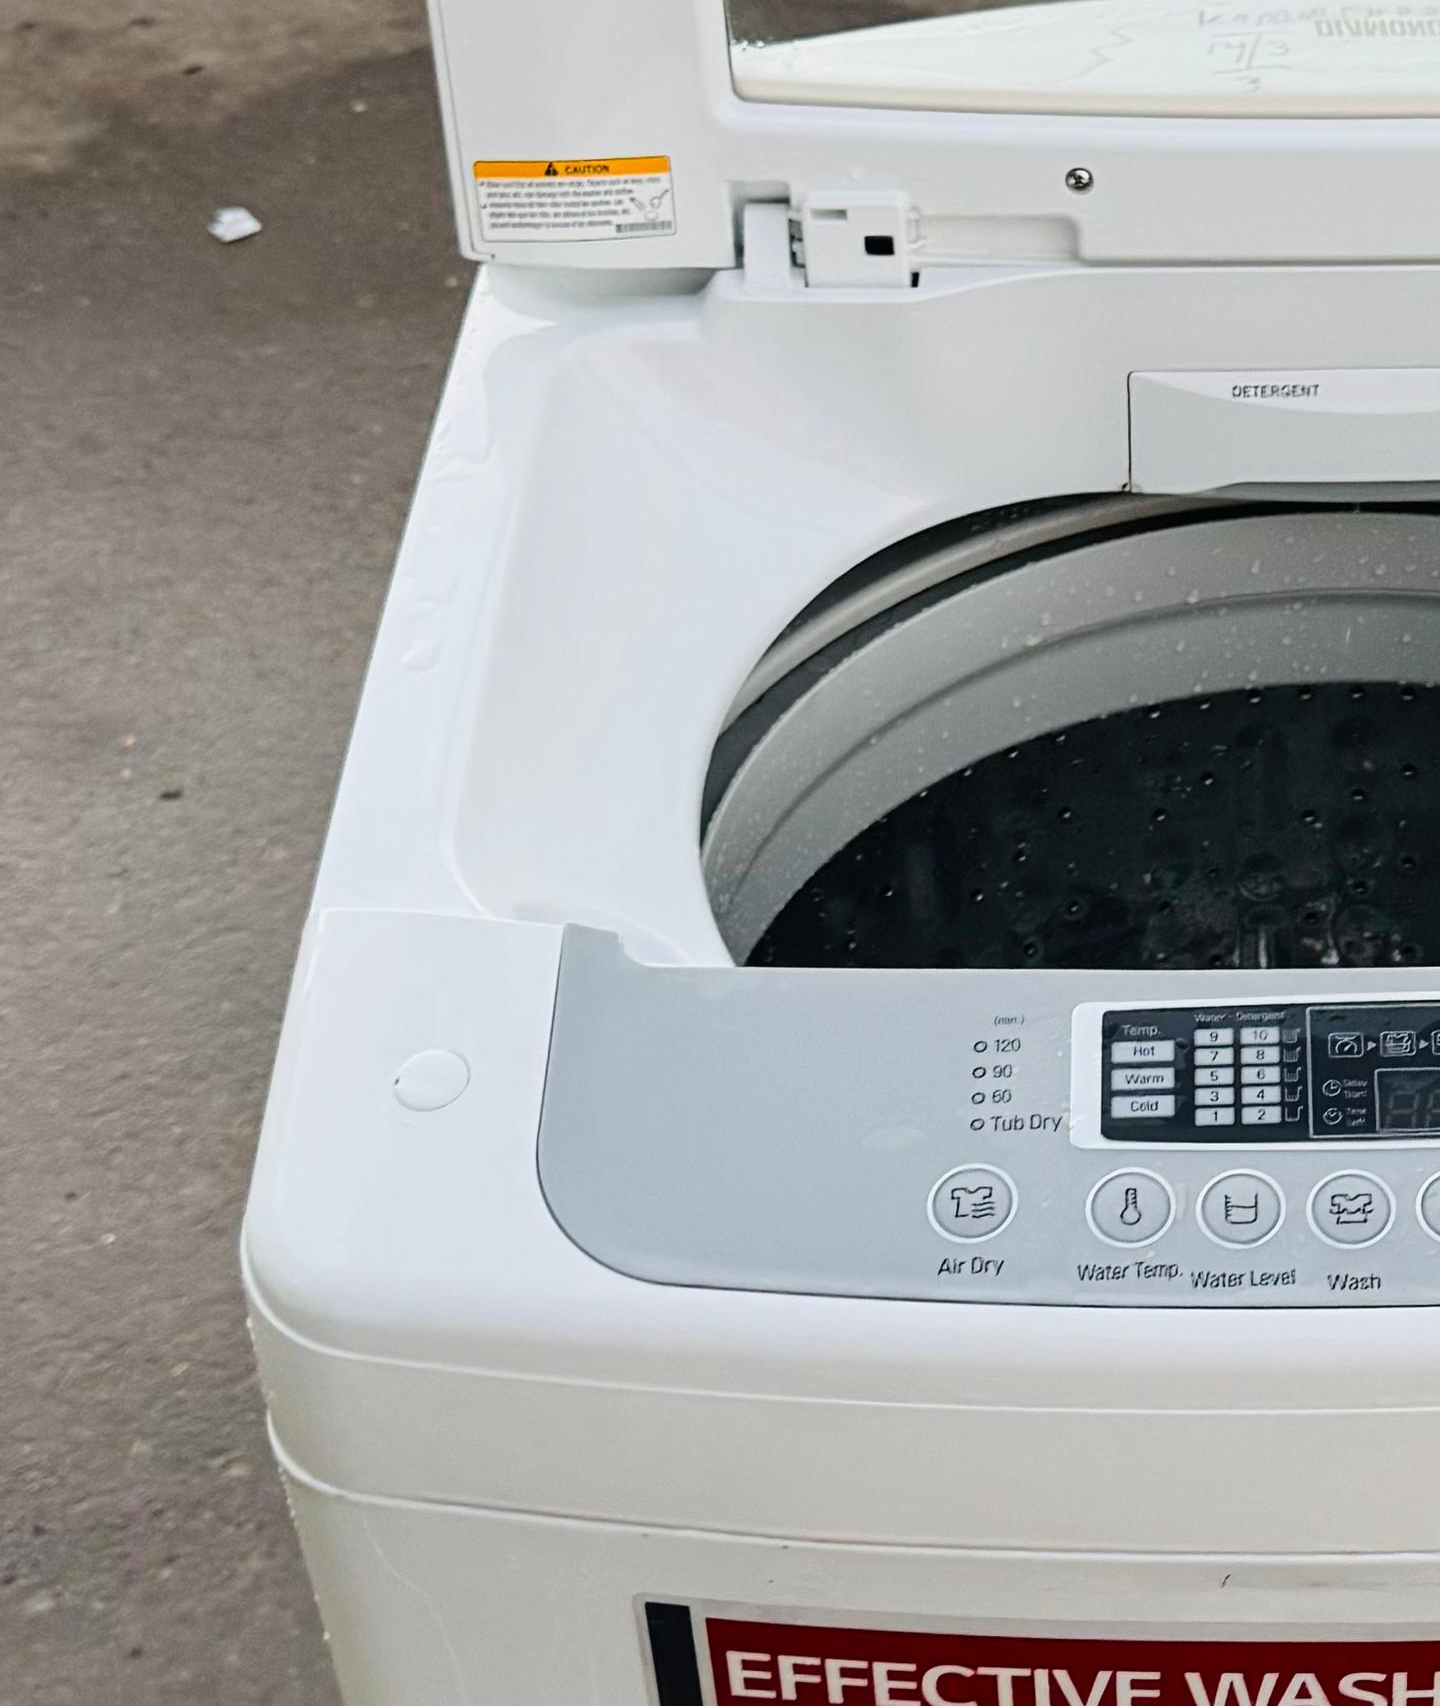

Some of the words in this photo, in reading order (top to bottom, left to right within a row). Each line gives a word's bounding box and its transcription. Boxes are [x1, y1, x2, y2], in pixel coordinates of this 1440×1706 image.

[564, 164, 610, 175] CAUTION
[1231, 384, 1320, 398] DETERGENT
[1121, 1024, 1161, 1037] Temp.
[1252, 1030, 1268, 1041] 10
[1209, 1032, 1219, 1042] 9
[995, 1038, 1021, 1053] 120
[1132, 1045, 1156, 1057] Hot
[1209, 1050, 1219, 1061] 7
[1256, 1049, 1265, 1060] 8
[992, 1064, 1013, 1078] 90
[1209, 1071, 1219, 1081] 5
[1256, 1069, 1266, 1080] 6
[1124, 1073, 1165, 1085] Warm
[991, 1089, 1012, 1103] 60
[1209, 1091, 1219, 1102] 3
[1256, 1089, 1266, 1099] 4
[1130, 1100, 1159, 1112] Cold
[1257, 1110, 1267, 1120] 2
[990, 1114, 1025, 1132] Tub
[1029, 1113, 1063, 1132] Dry
[937, 1257, 966, 1275] Air
[970, 1256, 1005, 1277] Dry
[1077, 1262, 1130, 1281] Water
[1134, 1262, 1183, 1280] Temp.
[1190, 1269, 1245, 1289] Water
[1250, 1268, 1297, 1287] Level
[1327, 1273, 1382, 1290] Wash
